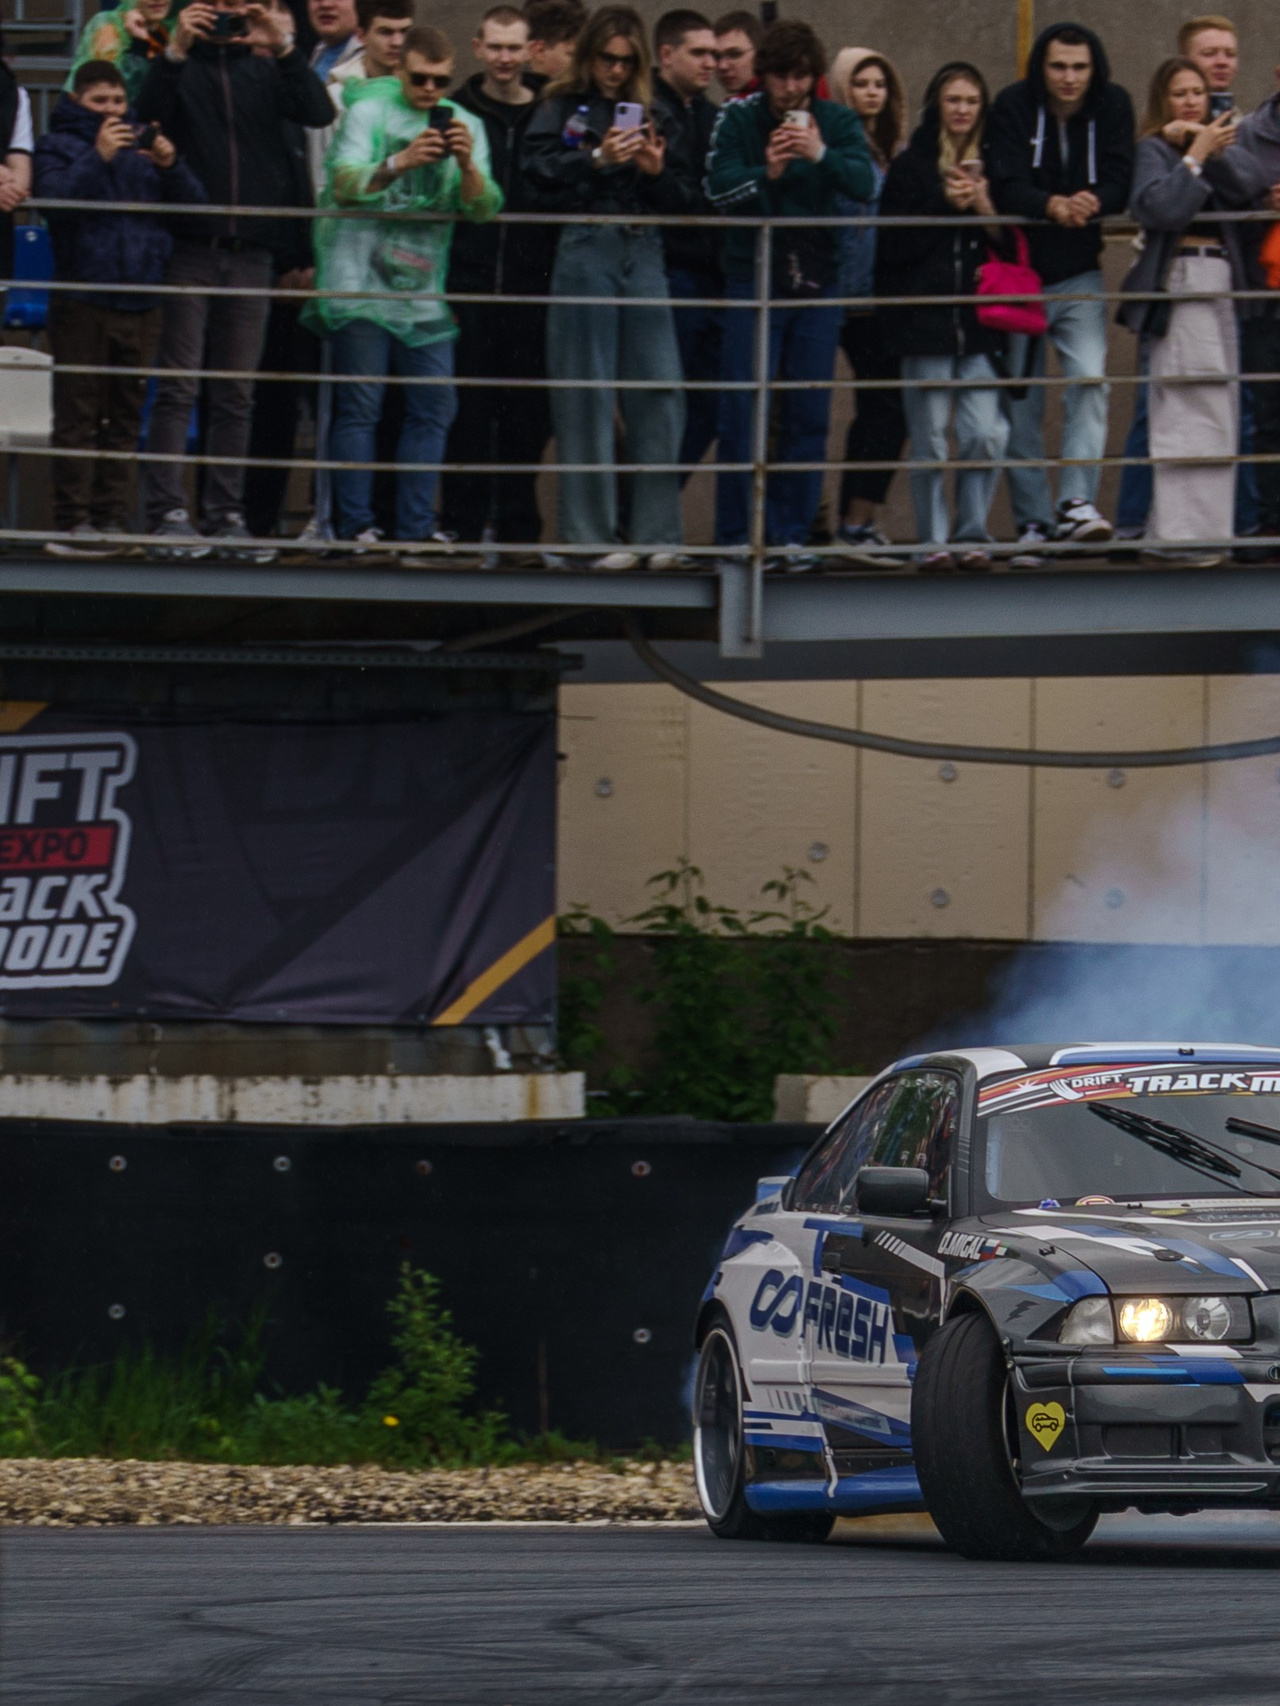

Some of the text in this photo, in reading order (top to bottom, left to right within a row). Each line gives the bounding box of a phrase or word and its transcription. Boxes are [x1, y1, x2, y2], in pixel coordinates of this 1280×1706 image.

[0, 831, 88, 862] EXPO
[0, 923, 118, 970] ODE
[1071, 1074, 1122, 1088] DRIFT
[1126, 1073, 1249, 1093] TRACK
